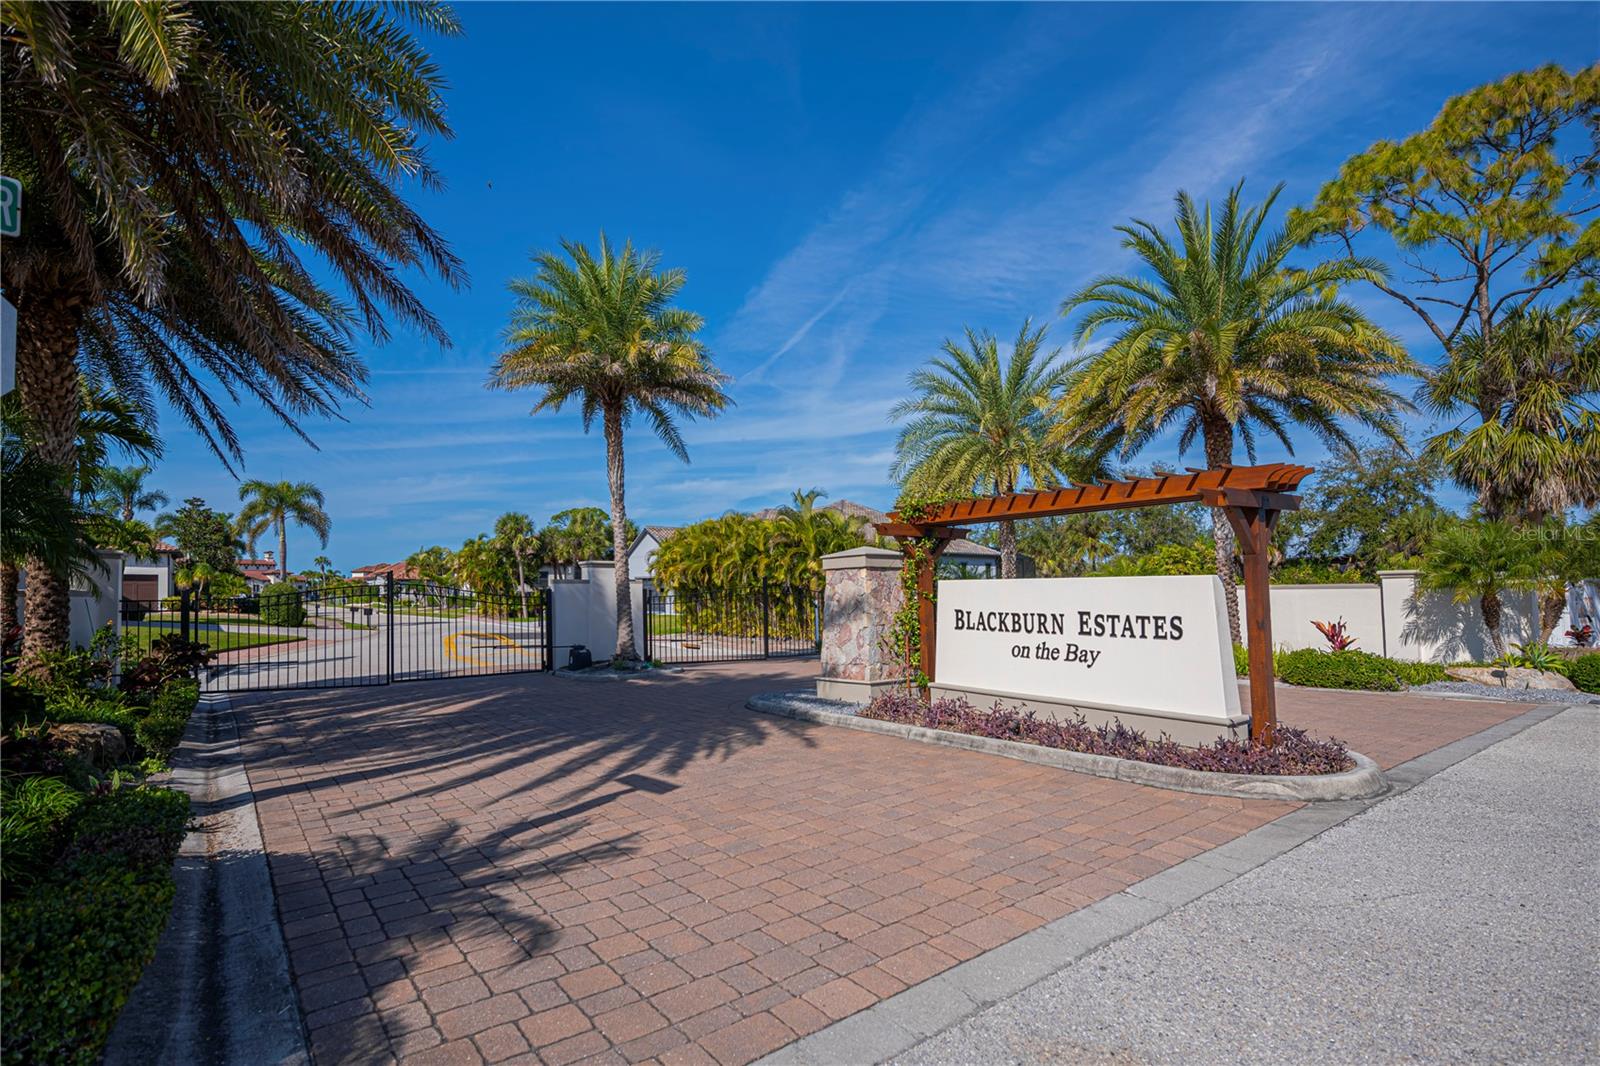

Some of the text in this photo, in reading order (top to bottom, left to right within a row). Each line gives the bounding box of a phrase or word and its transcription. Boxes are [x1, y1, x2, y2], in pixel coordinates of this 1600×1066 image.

[954, 608, 1184, 641] BLACKBURN ESTATES
[1011, 641, 1101, 669] on the Bay
